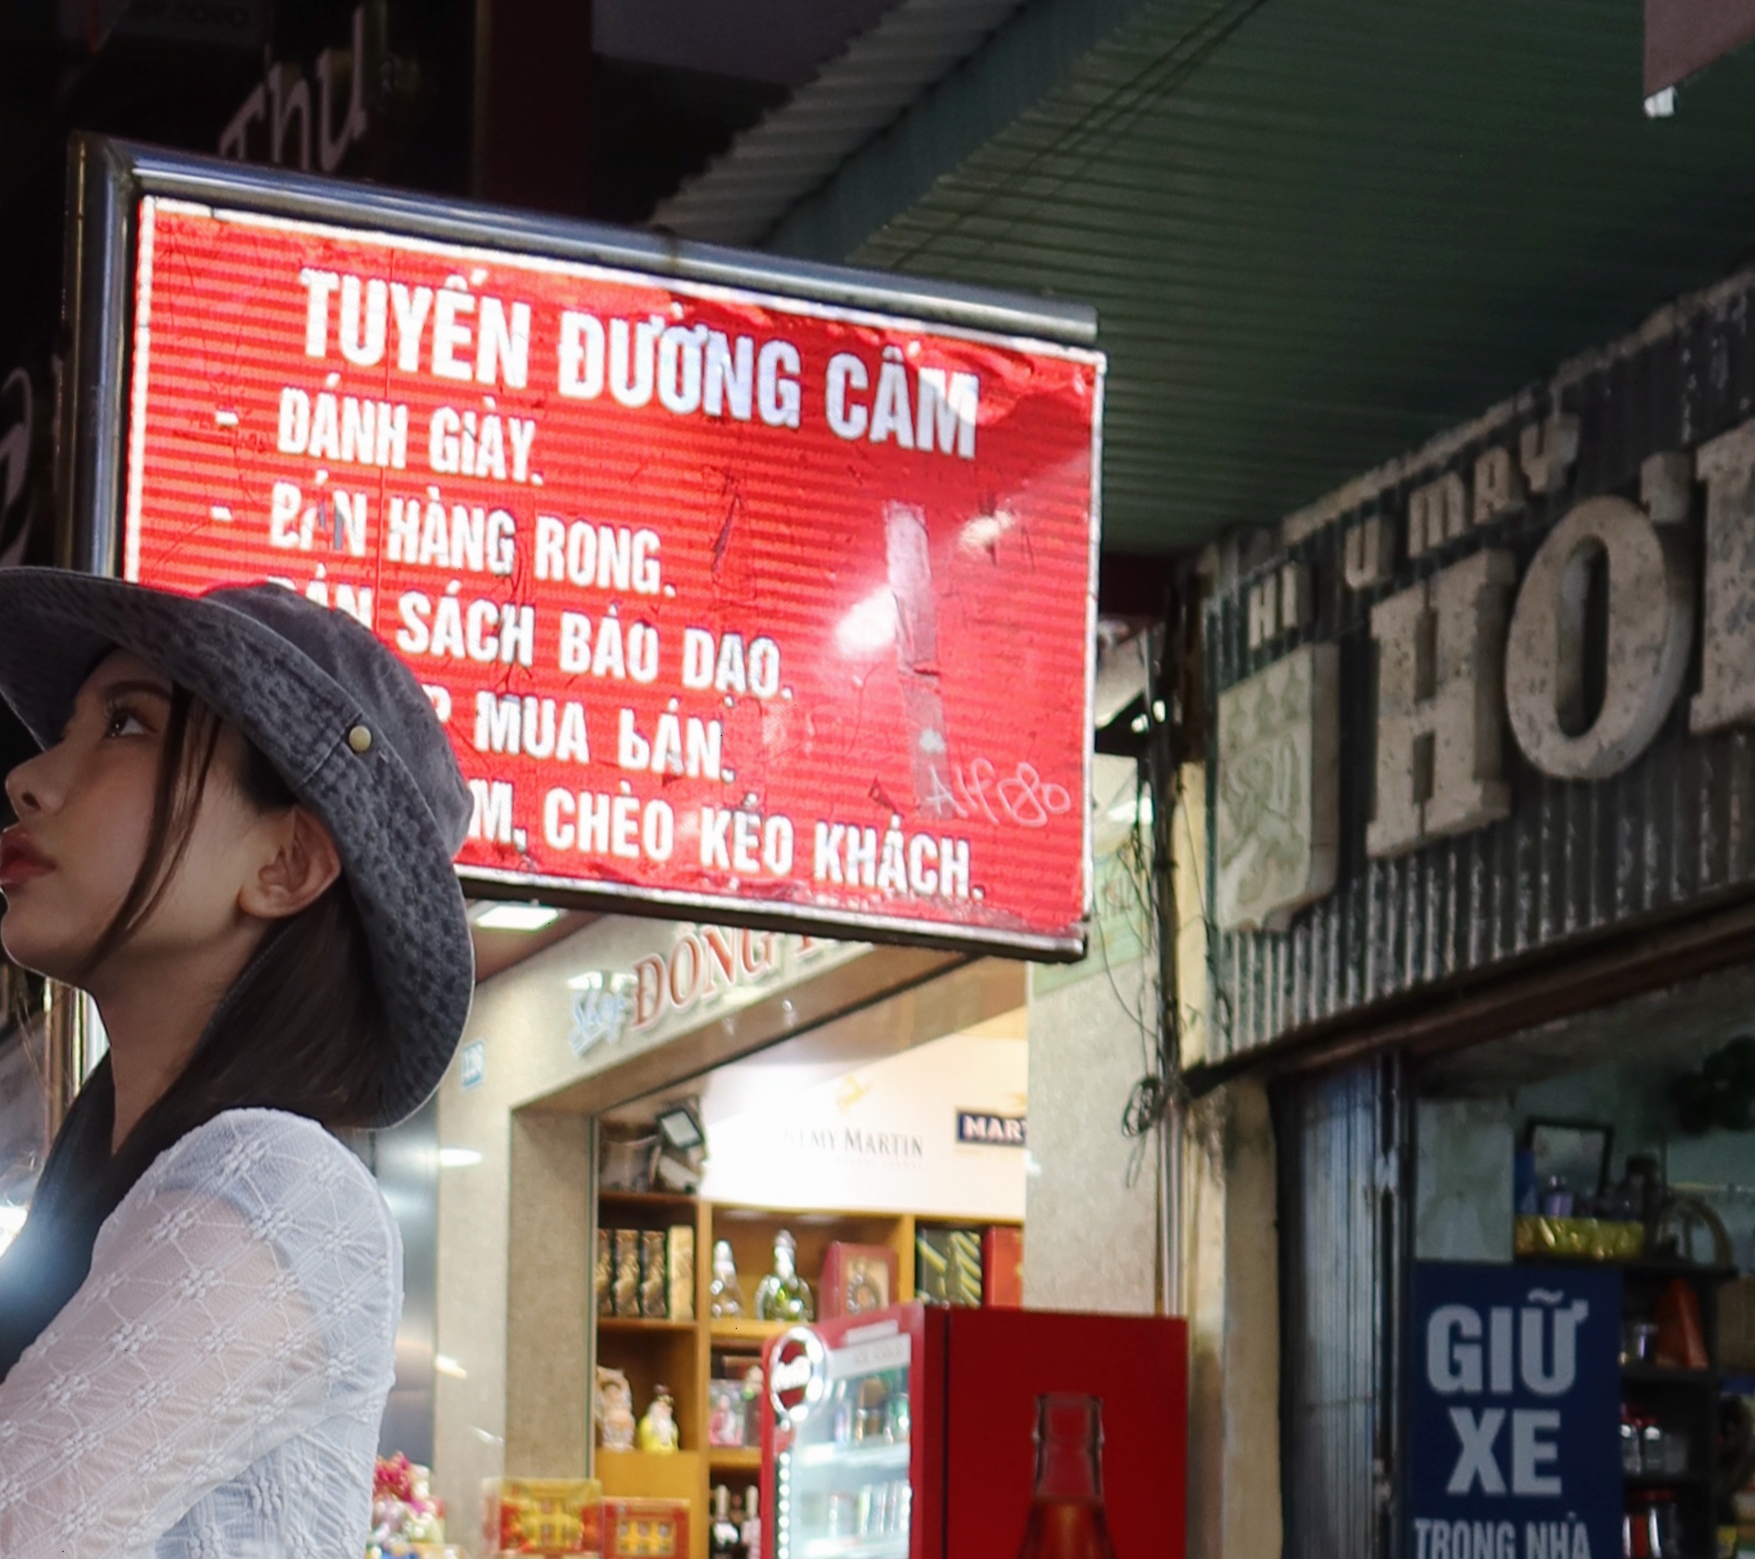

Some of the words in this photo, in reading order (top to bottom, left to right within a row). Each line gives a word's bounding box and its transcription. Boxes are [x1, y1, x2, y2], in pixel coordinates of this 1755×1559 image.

[300, 269, 531, 388] TUYẾN
[558, 302, 801, 427] ĐƯỜNG
[825, 340, 979, 459] CẤM
[277, 372, 408, 469] ĐÁNH
[386, 485, 516, 575] HÀNG
[396, 579, 535, 667] SÁCH
[474, 690, 589, 763] MUA
[545, 781, 675, 864] CHÈO
[700, 792, 795, 876] KÉO
[1427, 1289, 1588, 1395] GIỮ
[1447, 1407, 1562, 1495] XE
